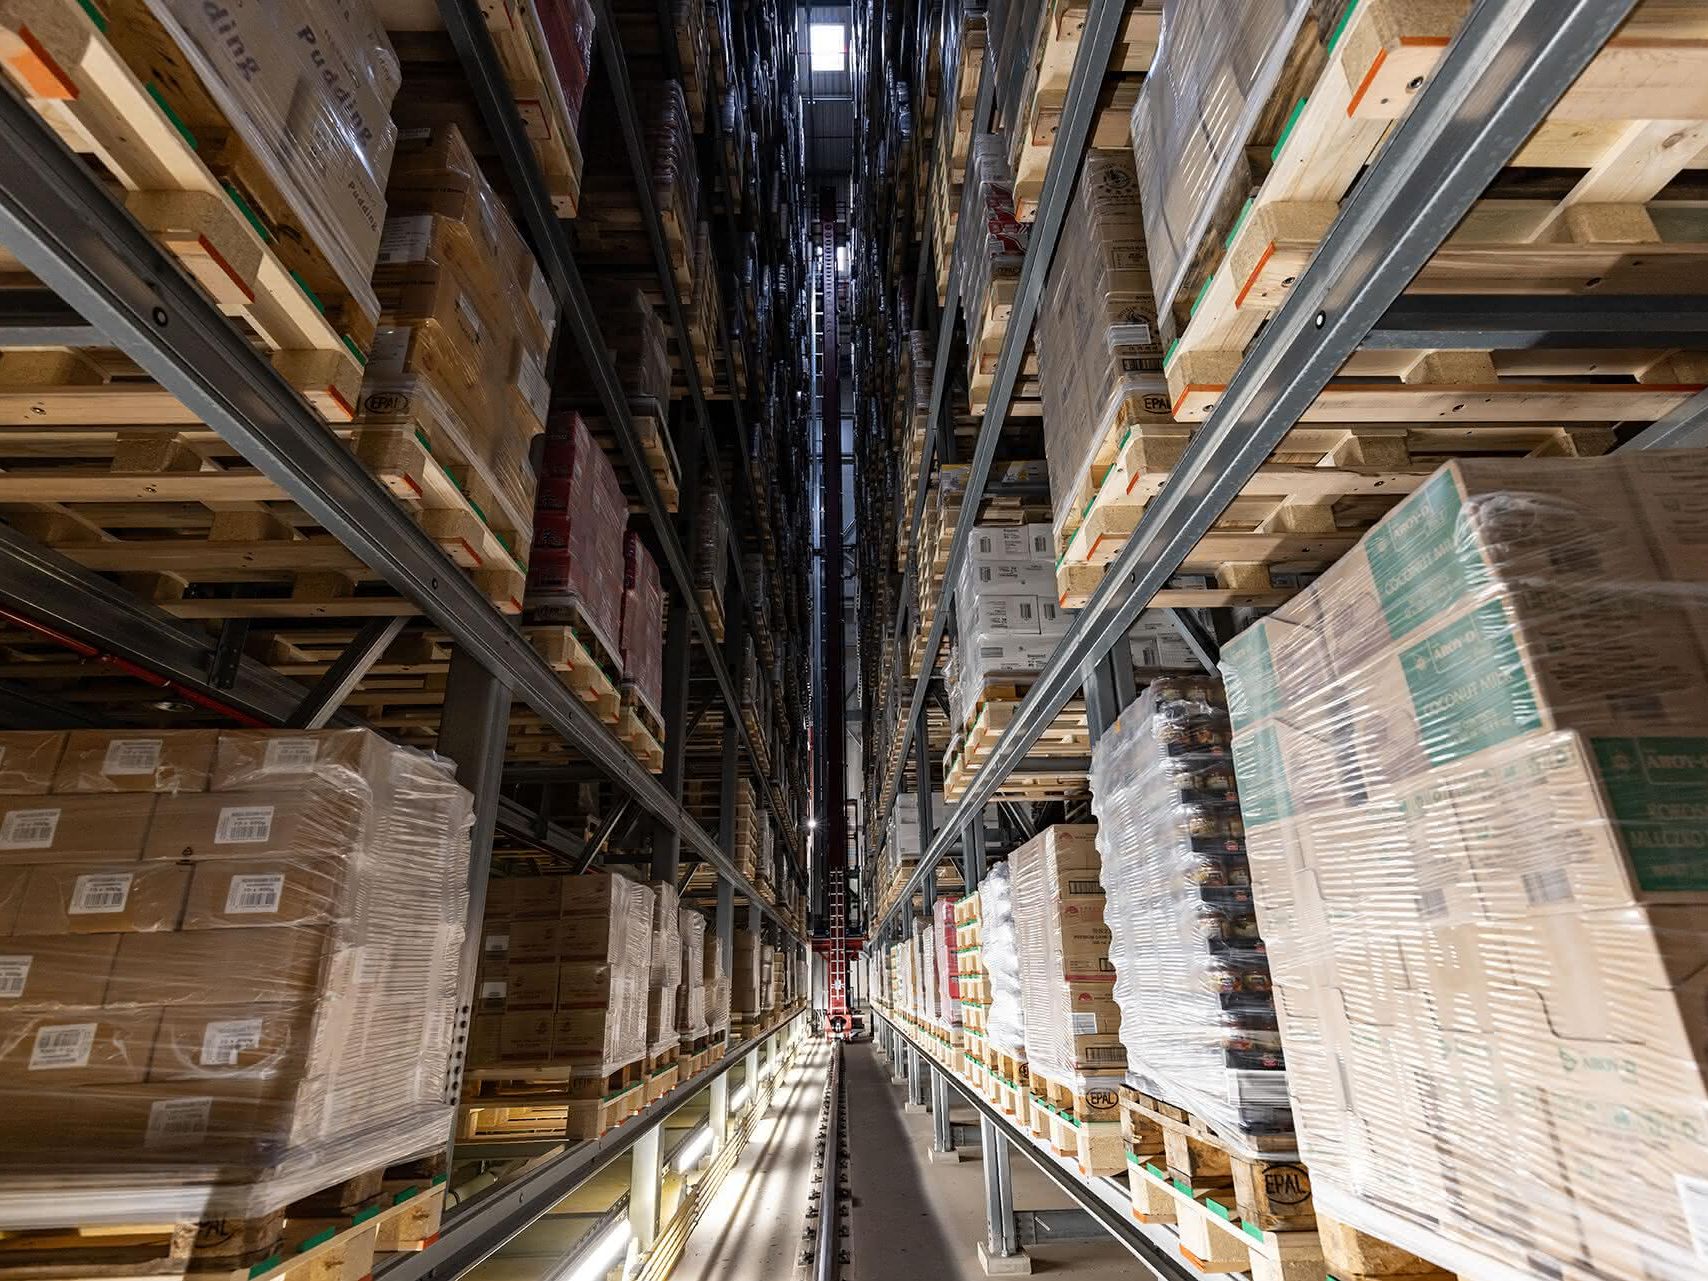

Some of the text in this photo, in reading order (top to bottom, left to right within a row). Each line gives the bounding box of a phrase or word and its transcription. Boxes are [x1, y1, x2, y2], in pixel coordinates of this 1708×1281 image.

[297, 25, 373, 147] Pudding
[347, 181, 378, 232] Pudding
[1090, 1091, 1114, 1105] EPAL
[1265, 1174, 1306, 1197] EPAL
